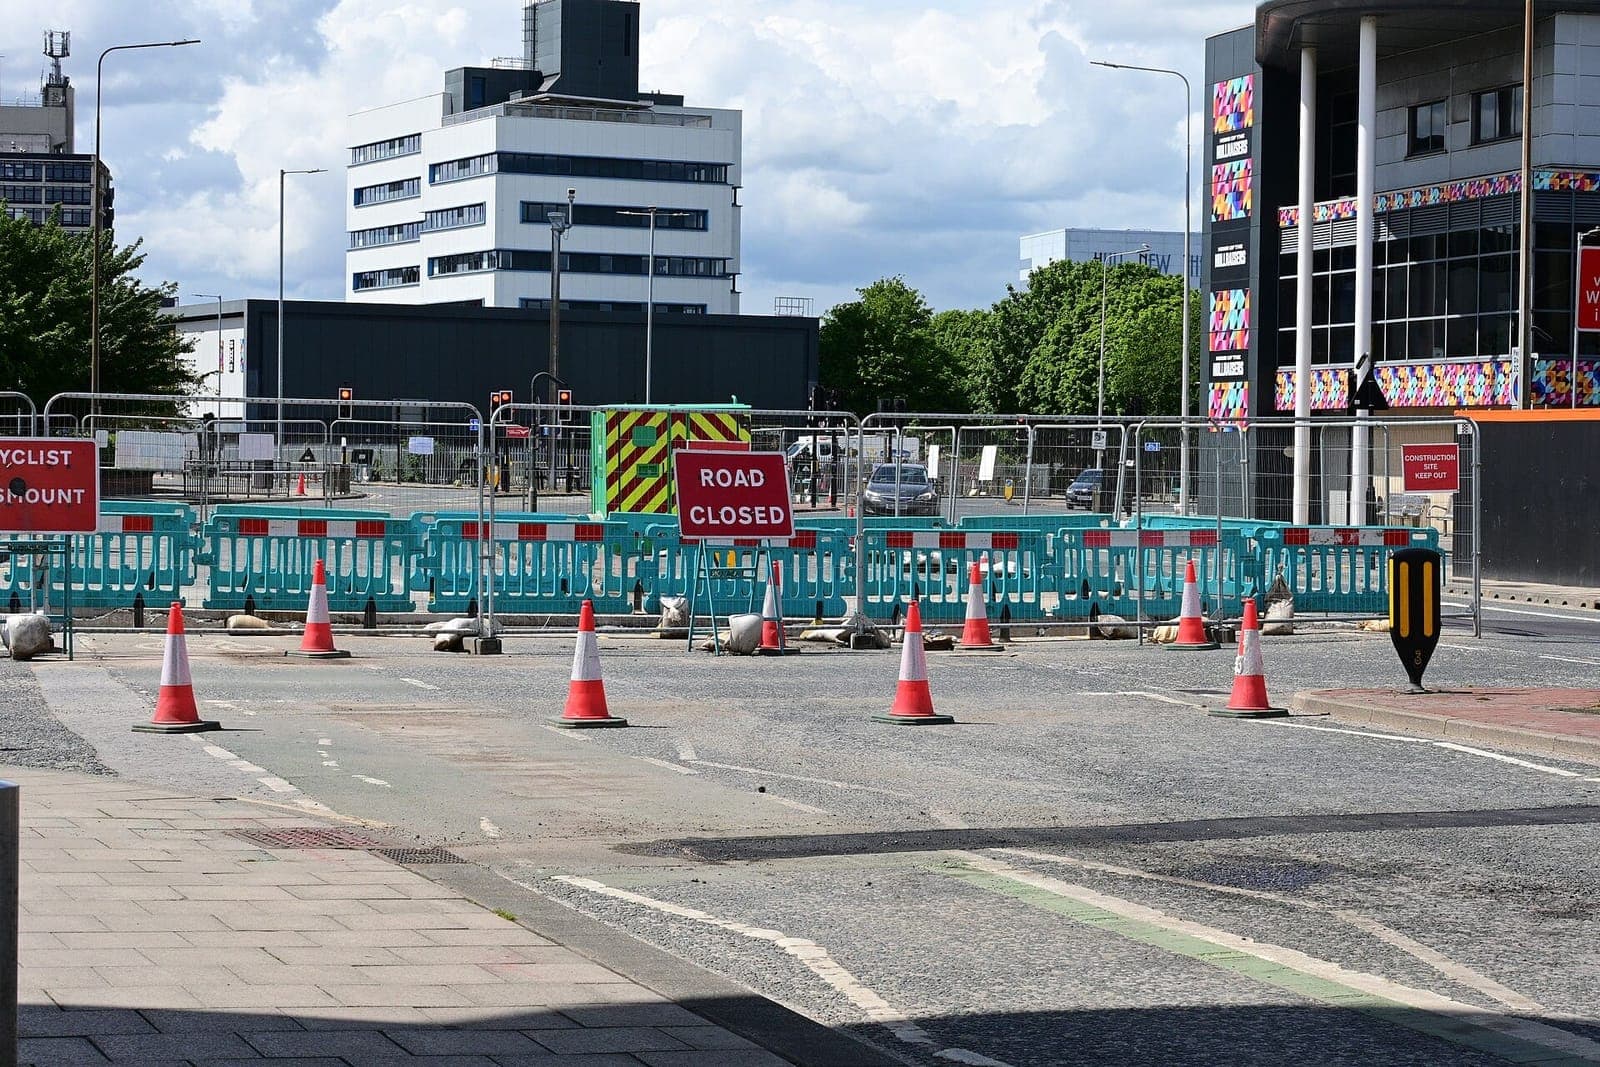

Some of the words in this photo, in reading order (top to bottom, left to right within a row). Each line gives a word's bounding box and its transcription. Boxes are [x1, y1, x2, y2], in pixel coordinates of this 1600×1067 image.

[0, 449, 73, 466] YCLIST
[1404, 454, 1456, 462] CONSTRUCTION
[700, 468, 765, 487] ROAD
[689, 506, 785, 525] CLOSED
